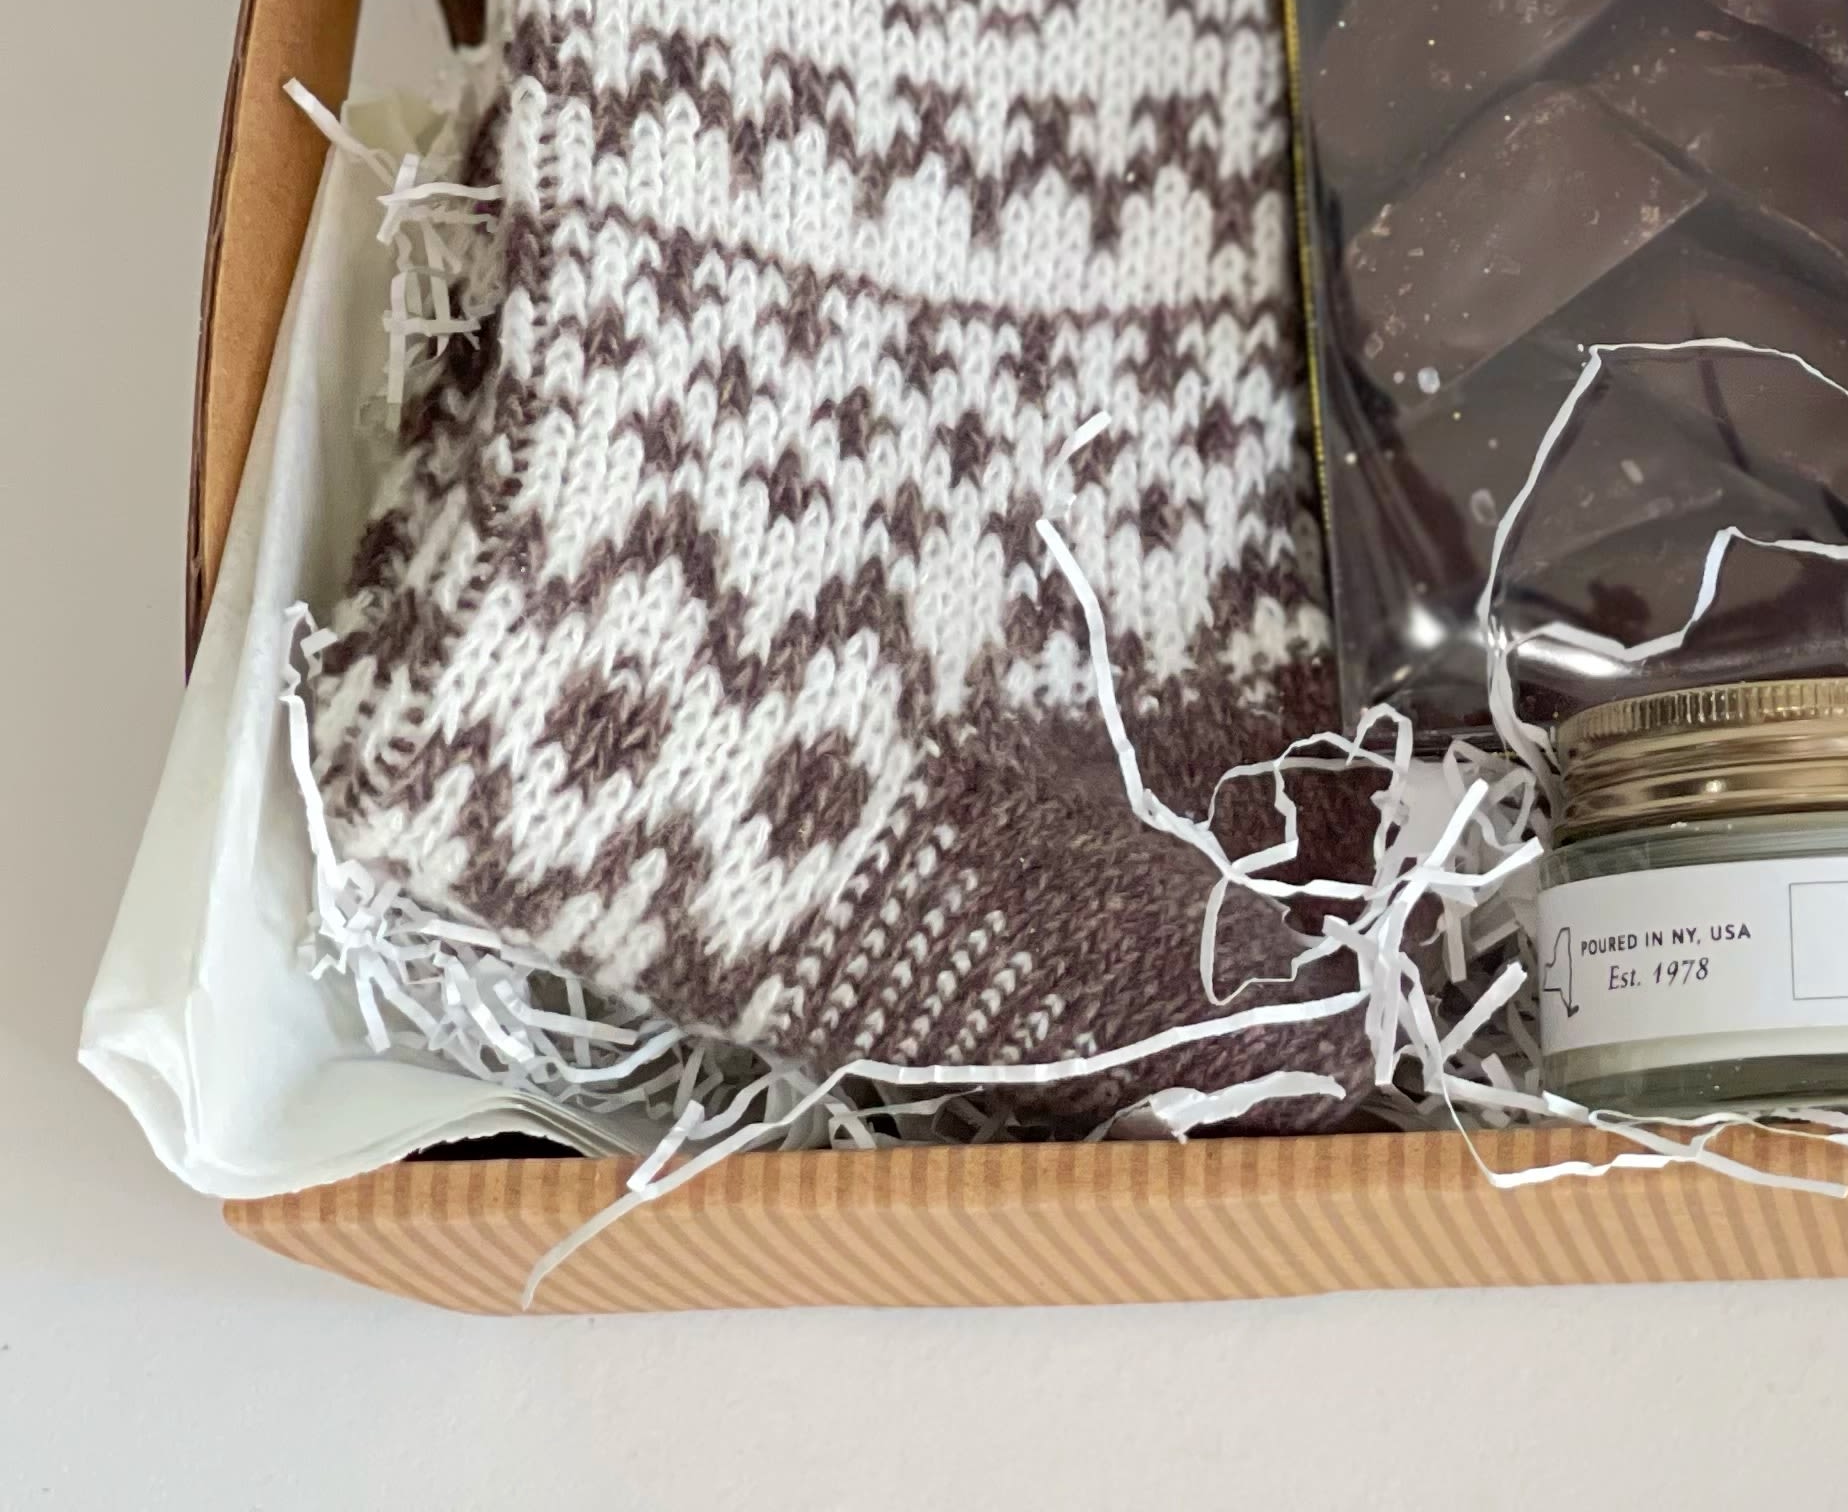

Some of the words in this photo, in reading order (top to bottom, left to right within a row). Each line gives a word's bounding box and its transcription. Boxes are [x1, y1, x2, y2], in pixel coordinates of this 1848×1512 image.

[1580, 933, 1638, 956] POURED
[1645, 932, 1664, 948] IN
[1671, 928, 1702, 946] NY,
[1710, 923, 1752, 942] USA
[1607, 963, 1641, 991] Est.
[1652, 956, 1710, 986] 1978
